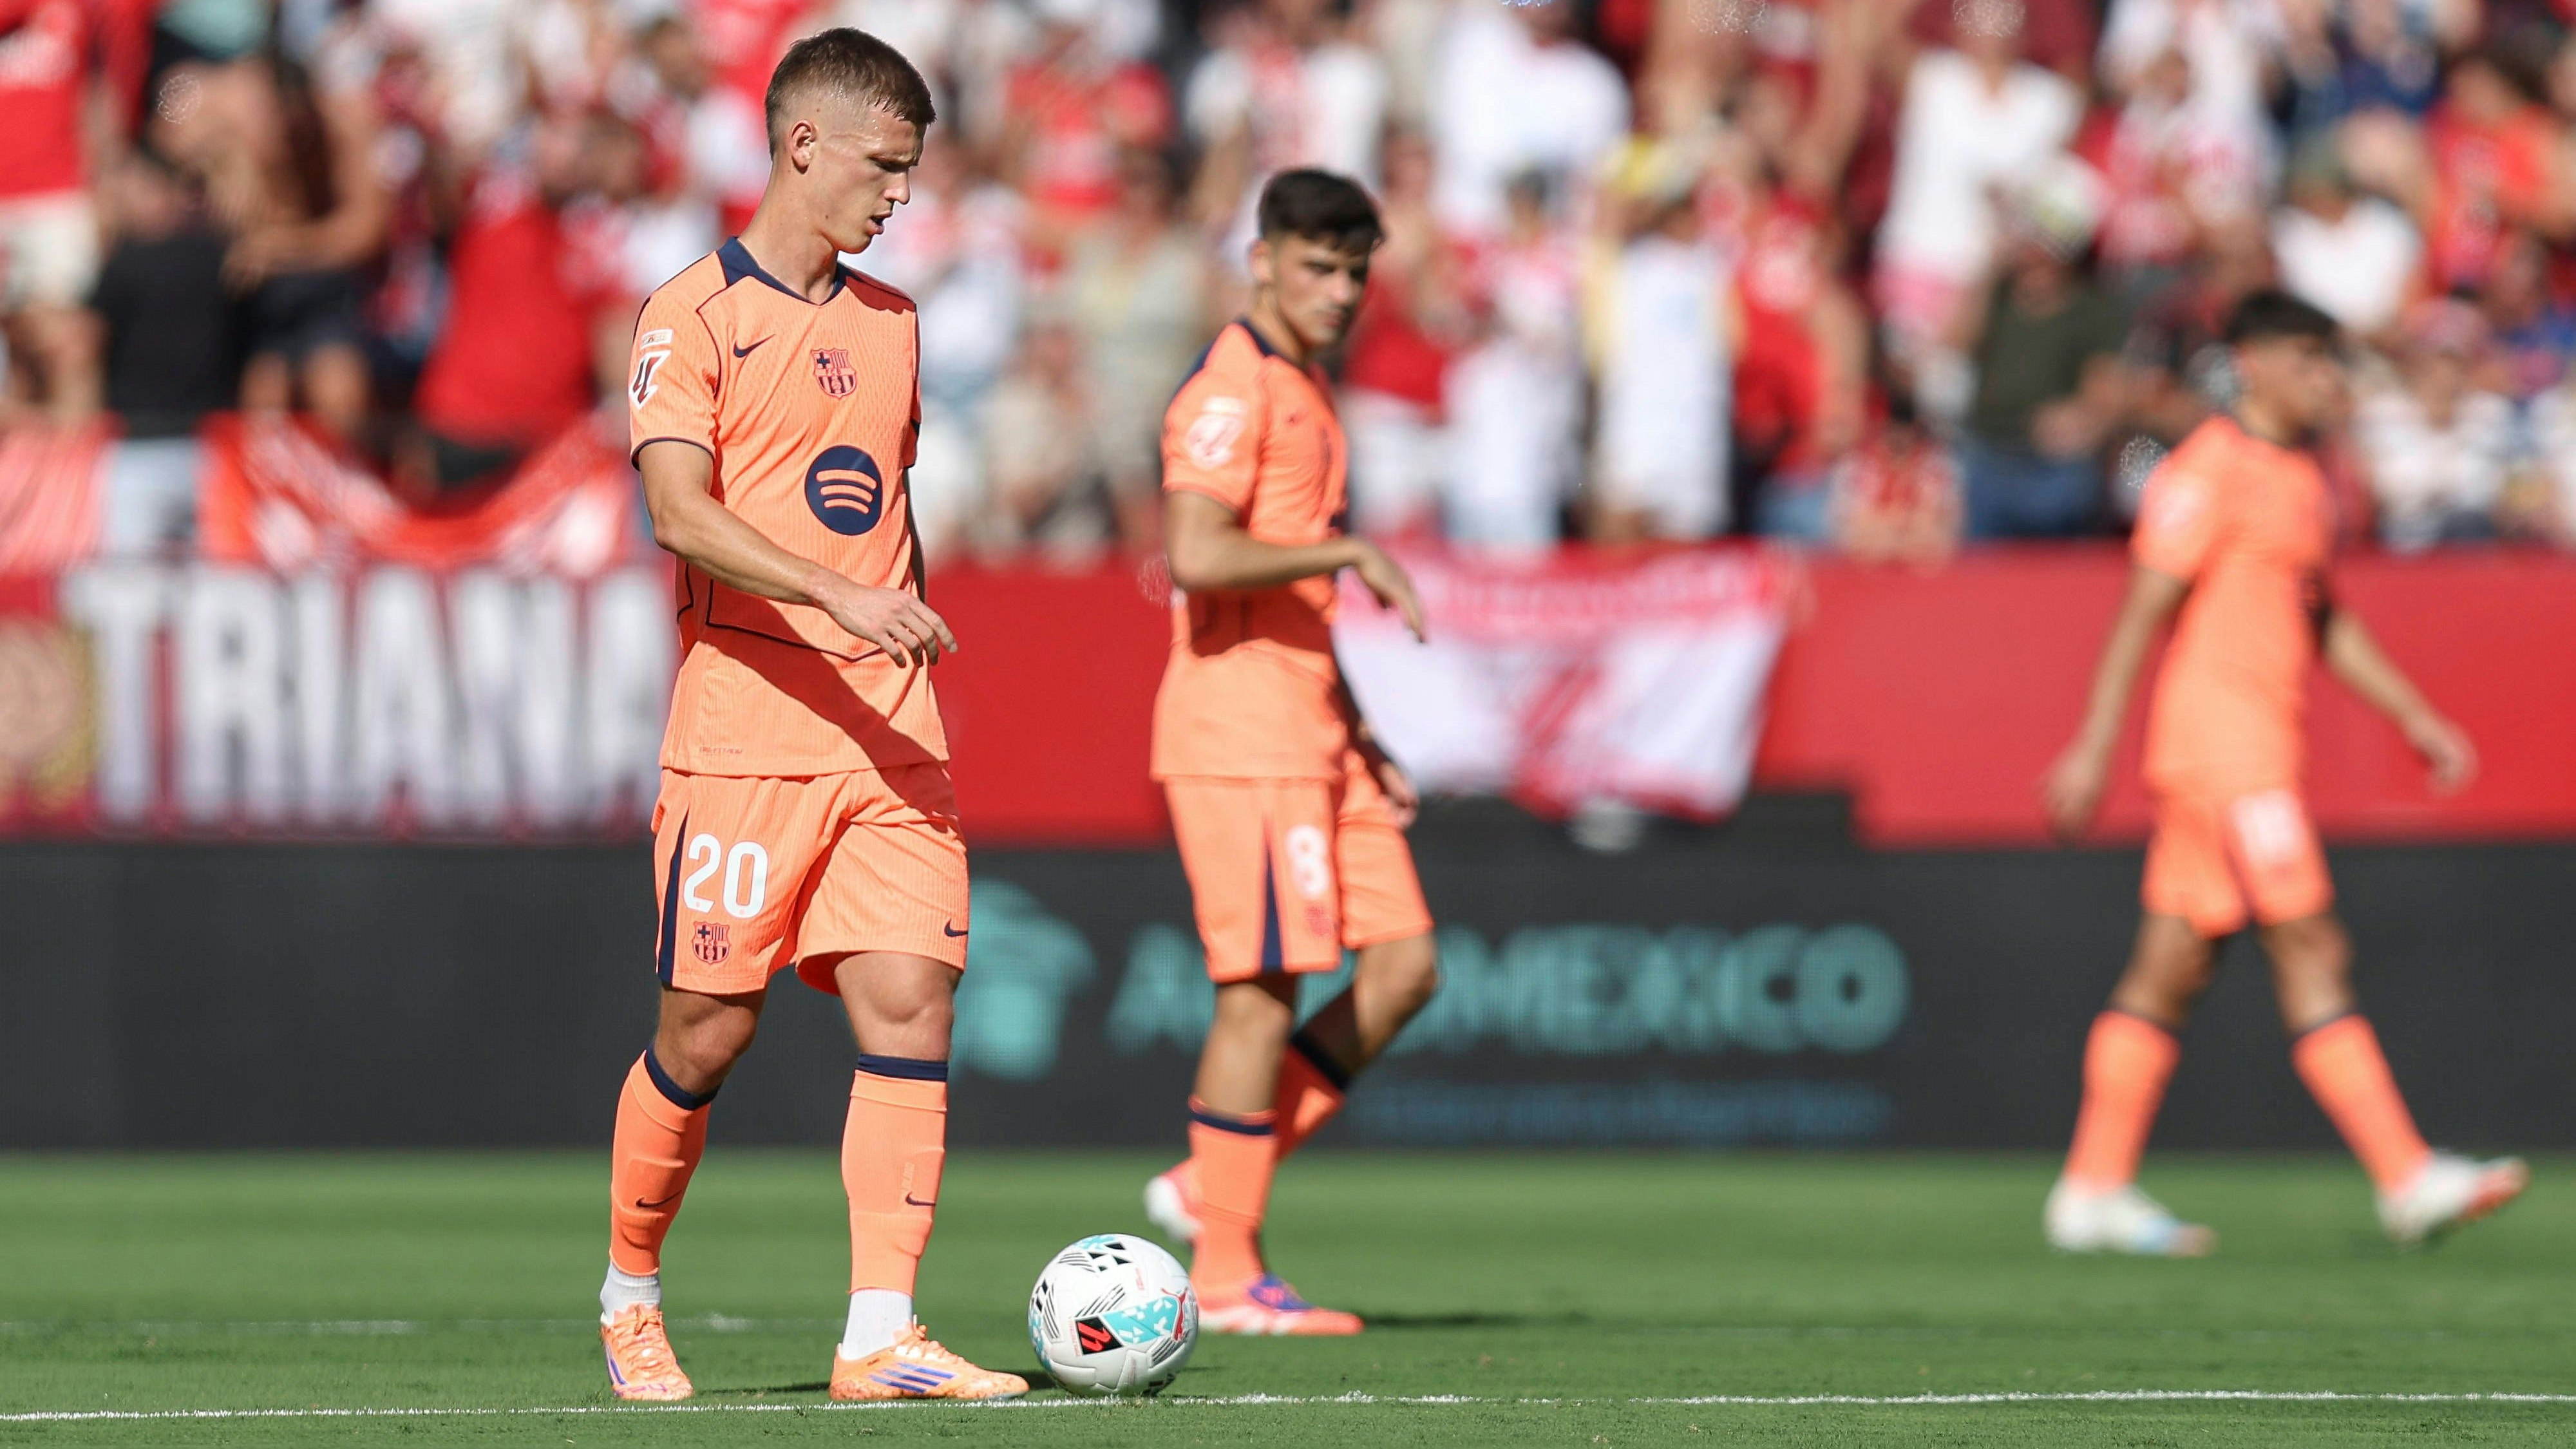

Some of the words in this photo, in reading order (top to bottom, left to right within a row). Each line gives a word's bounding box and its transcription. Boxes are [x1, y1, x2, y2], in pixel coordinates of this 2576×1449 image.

[70, 564, 672, 823] TRIANA
[683, 833, 769, 919] 20
[1285, 825, 1330, 899] 8
